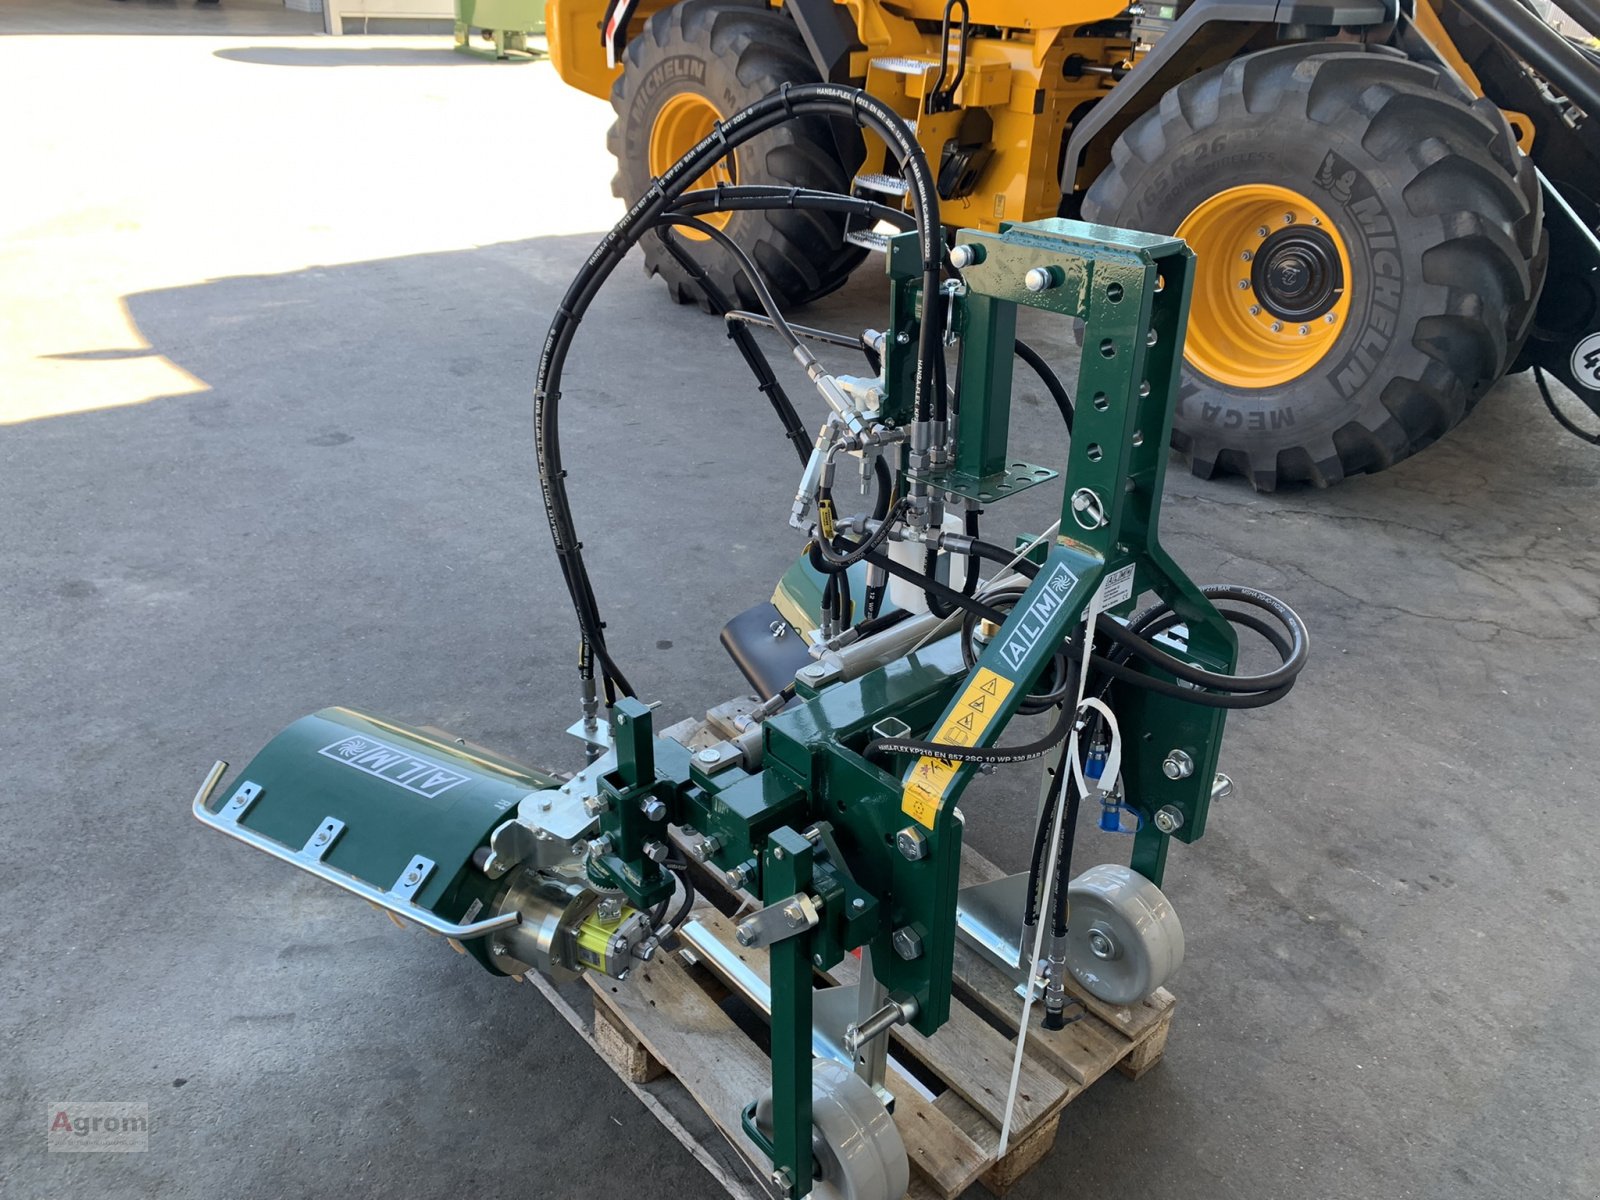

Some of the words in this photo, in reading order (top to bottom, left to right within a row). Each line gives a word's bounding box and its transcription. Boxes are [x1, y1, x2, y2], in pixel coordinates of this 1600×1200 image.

[632, 56, 706, 122] MICHELIN
[816, 86, 850, 99] HANSA-FLEX
[856, 97, 868, 107] P213
[876, 110, 886, 119] 857
[885, 119, 895, 129] 2SC
[910, 163, 922, 177] BAR
[916, 181, 927, 202] MSHA
[588, 232, 616, 264] HANSA-FEX
[618, 215, 630, 227] P213
[638, 198, 646, 206] 857
[665, 170, 674, 178] WP
[684, 151, 694, 161] BAR
[696, 138, 711, 150] MSHA
[1337, 196, 1400, 398] MICHELIN
[913, 360, 924, 404] HANSA-FLEX
[1201, 402, 1296, 431] MEGA
[1008, 591, 1057, 663] ALM
[358, 749, 458, 789] ALM
[910, 748, 932, 758] KP210
[1026, 752, 1041, 760] BAR
